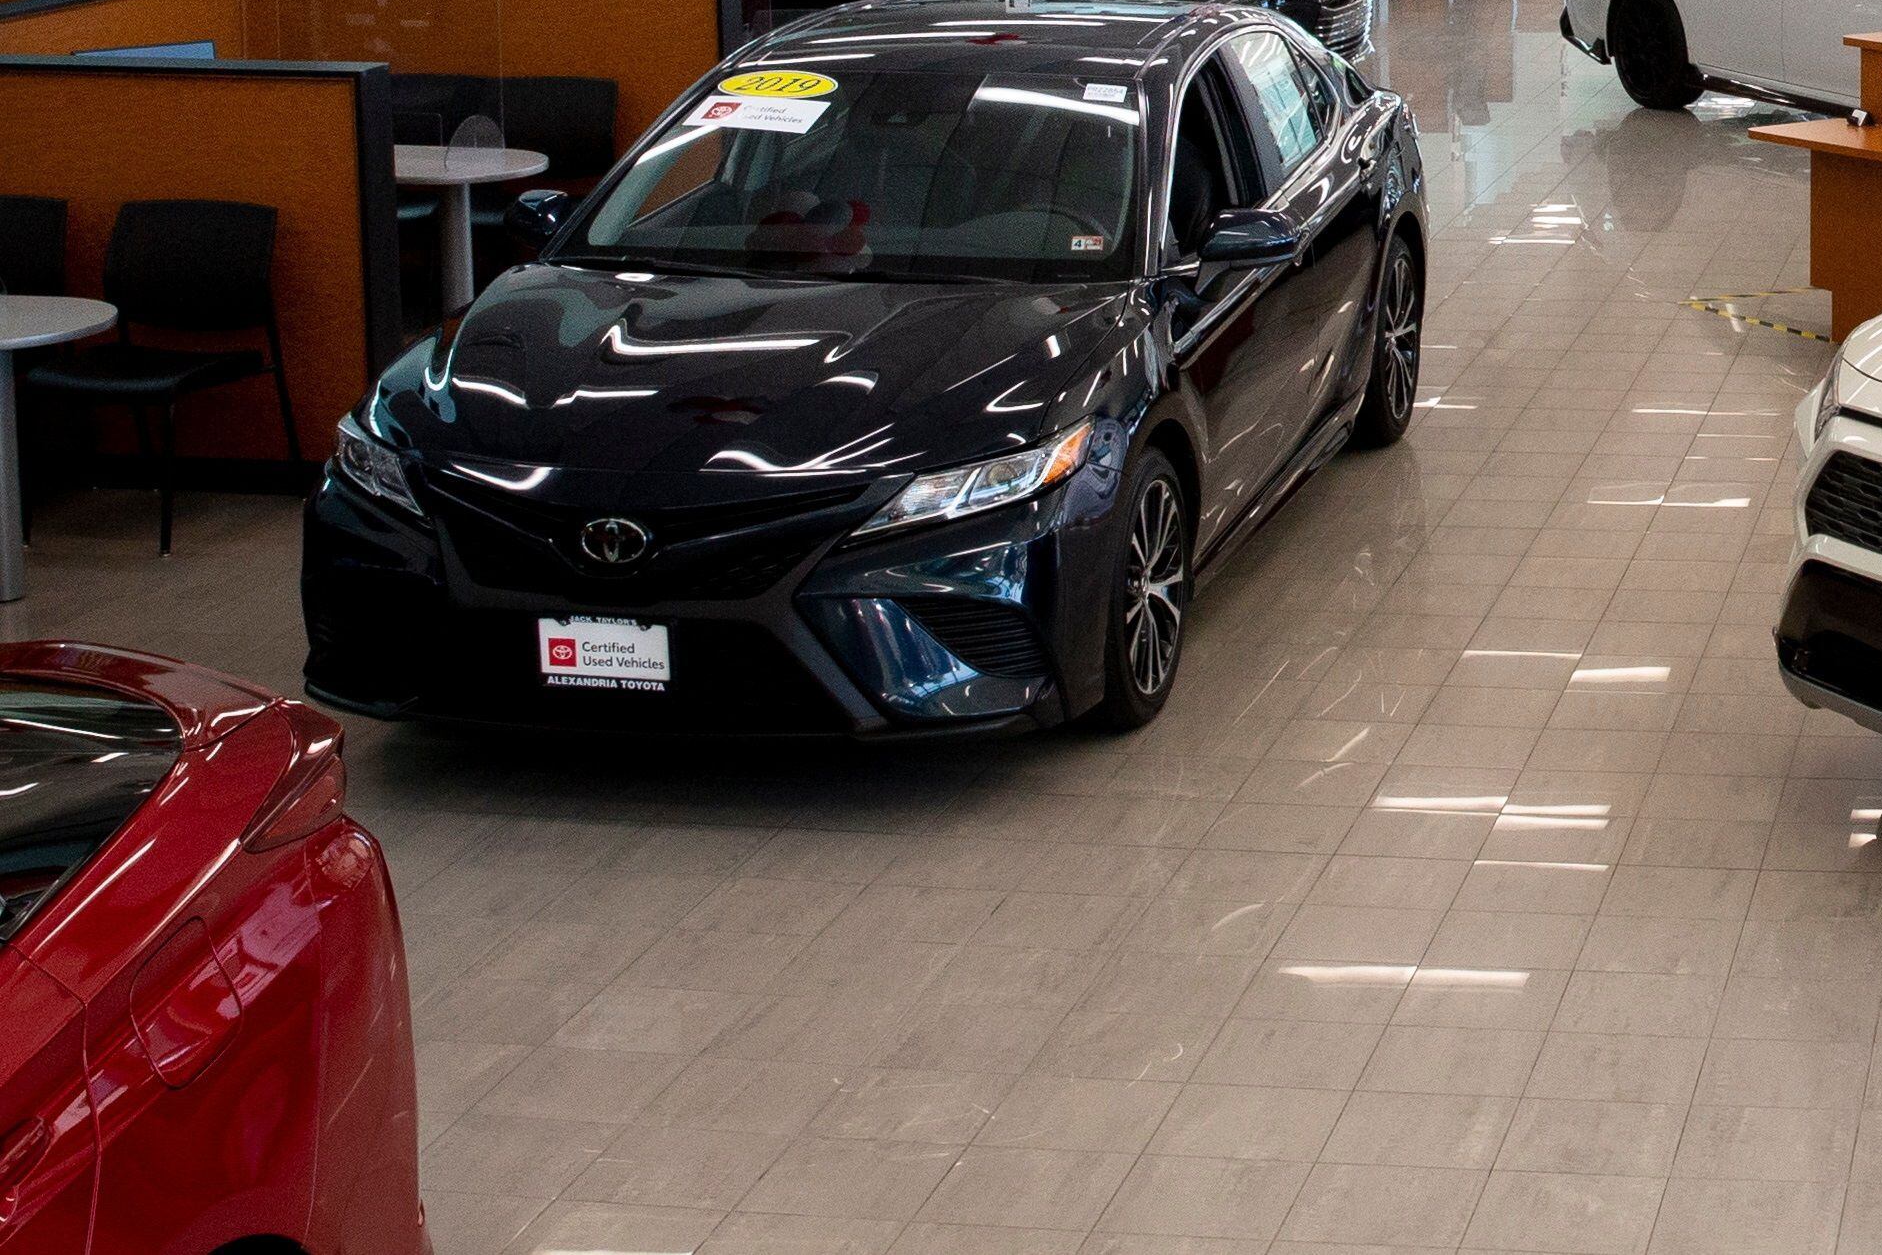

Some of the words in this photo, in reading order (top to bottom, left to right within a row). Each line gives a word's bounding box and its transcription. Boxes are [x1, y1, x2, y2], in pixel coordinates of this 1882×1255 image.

[734, 76, 822, 93] 2019
[569, 615, 593, 624] JACK
[581, 641, 635, 654] Certified
[582, 656, 613, 668] Used
[616, 657, 665, 670] Vehicles
[547, 676, 618, 689] ALEXANDRIA
[620, 680, 666, 692] TOYOTA
